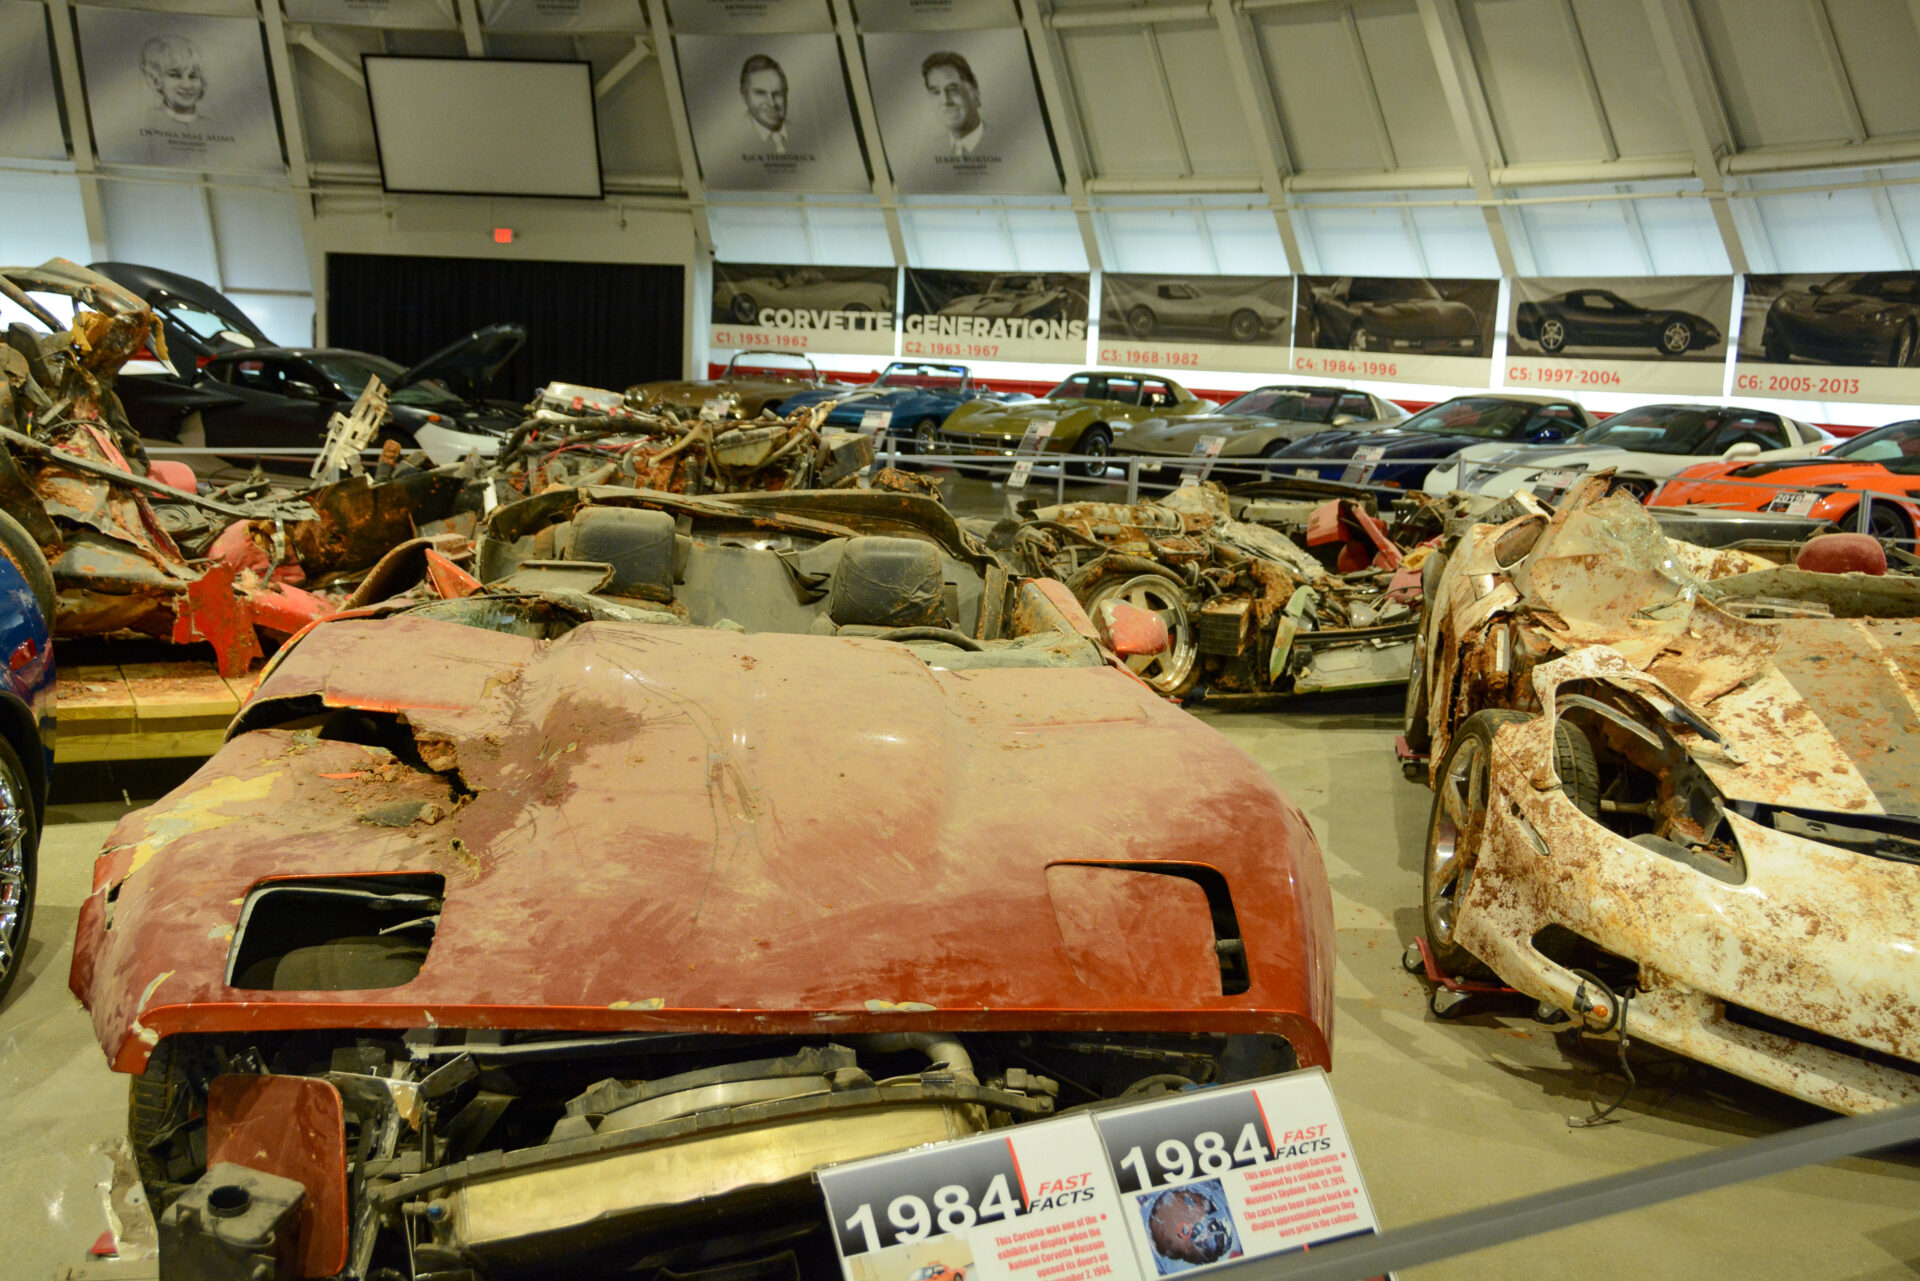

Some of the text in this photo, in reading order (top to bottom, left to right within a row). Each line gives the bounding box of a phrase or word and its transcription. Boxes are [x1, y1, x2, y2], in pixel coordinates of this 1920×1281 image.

[759, 308, 1085, 340] CORVETTE GENERATIONS
[716, 332, 808, 347] C1: 1953-1962
[905, 342, 999, 357] C2: 1963-1967
[1101, 349, 1198, 365] C3: 1968-1982
[1296, 357, 1397, 376] C4: 1984-1996
[1509, 367, 1620, 385] C5: 1997-2004
[1738, 374, 1859, 394] C6: 2005-2013
[1282, 1124, 1328, 1144] FAST
[1120, 1122, 1270, 1191] 1984
[1275, 1138, 1331, 1160] FACTS
[1243, 1172, 1258, 1181] This
[1259, 1169, 1272, 1179] was
[1272, 1165, 1284, 1176] one
[1292, 1159, 1309, 1172] eight
[1309, 1154, 1339, 1167] Corvettes
[1038, 1172, 1092, 1196] FAST
[1249, 1178, 1285, 1192] swallowed
[1298, 1168, 1325, 1182] sinkhole
[1028, 1187, 1095, 1214] FACTS
[1243, 1211, 1256, 1220] The
[1257, 1207, 1272, 1217] cars
[1272, 1203, 1288, 1214] have
[1288, 1198, 1305, 1211] been
[1305, 1194, 1326, 1207] placed
[1326, 1191, 1342, 1201] back
[1244, 1191, 1277, 1206] Museum's
[1277, 1185, 1307, 1199] Skydome
[845, 1173, 1021, 1251] 1984
[1251, 1200, 1355, 1232] display approximately where they
[995, 1236, 1012, 1247] This
[1013, 1228, 1045, 1243] Corvette
[1045, 1224, 1062, 1235] was
[1061, 1221, 1076, 1232] one
[1085, 1215, 1098, 1225] the
[1279, 1226, 1296, 1238] were
[1296, 1222, 1312, 1235] prior
[997, 1245, 1029, 1260] exhibits
[1039, 1235, 1067, 1250] display
[1067, 1230, 1088, 1243] when
[1088, 1227, 1101, 1238] the
[1008, 1240, 1105, 1272] National Corvette Museum
[1037, 1263, 1065, 1278] opened
[1077, 1255, 1098, 1267] doors
